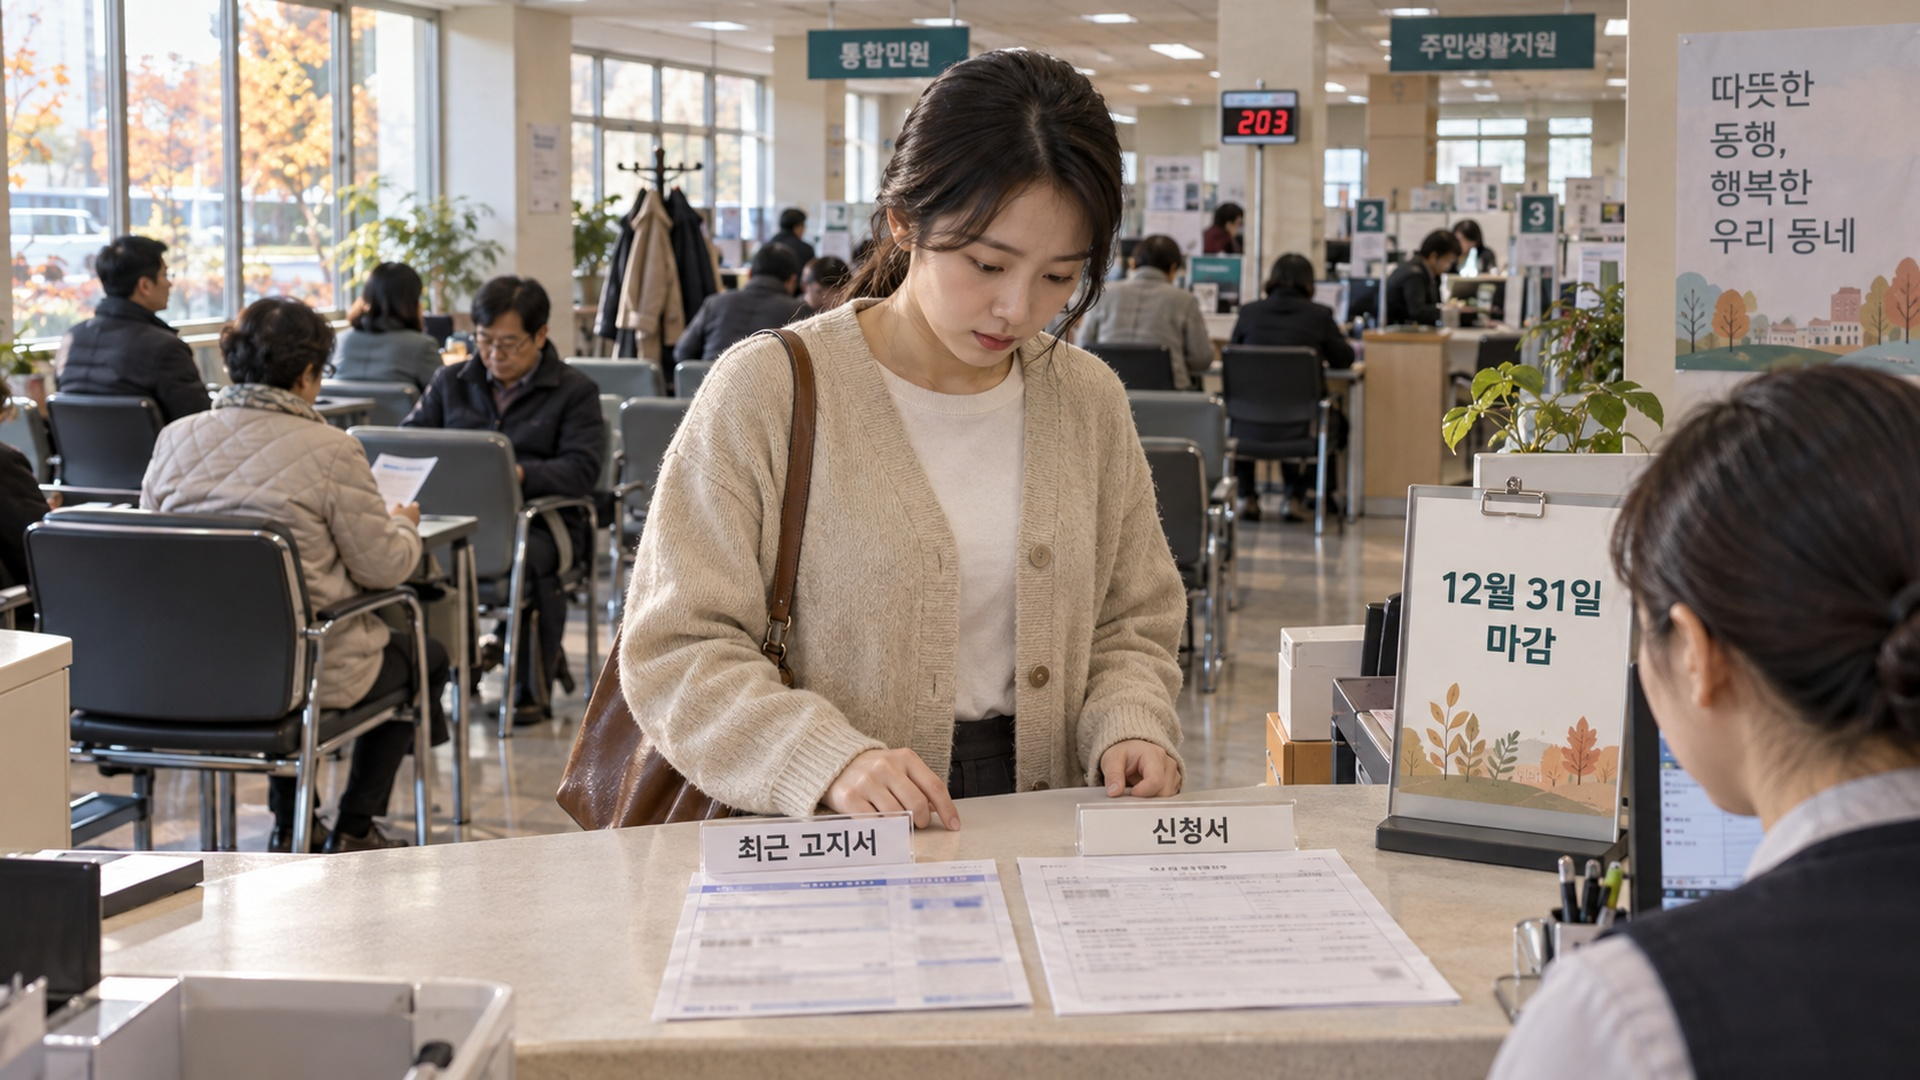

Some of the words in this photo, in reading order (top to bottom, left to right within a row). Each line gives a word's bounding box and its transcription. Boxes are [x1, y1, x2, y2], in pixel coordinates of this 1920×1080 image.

[839, 40, 930, 70] 통합민원
[1419, 31, 1557, 60] 주민생활지원
[1711, 69, 1815, 109] 따뜻한
[1238, 109, 1288, 135] 203
[1709, 120, 1787, 159] 동행,
[1710, 168, 1813, 207] 행복한
[1362, 204, 1378, 227] 2
[1528, 202, 1546, 226] 3
[1709, 217, 1775, 255] 우리
[1787, 216, 1856, 255] 동네
[1442, 571, 1516, 612] 12월
[1525, 576, 1602, 618] 31일
[1486, 623, 1557, 666] 마감
[737, 833, 790, 863] 최근
[799, 828, 877, 858] 고지서
[1152, 816, 1229, 845] 신청서
